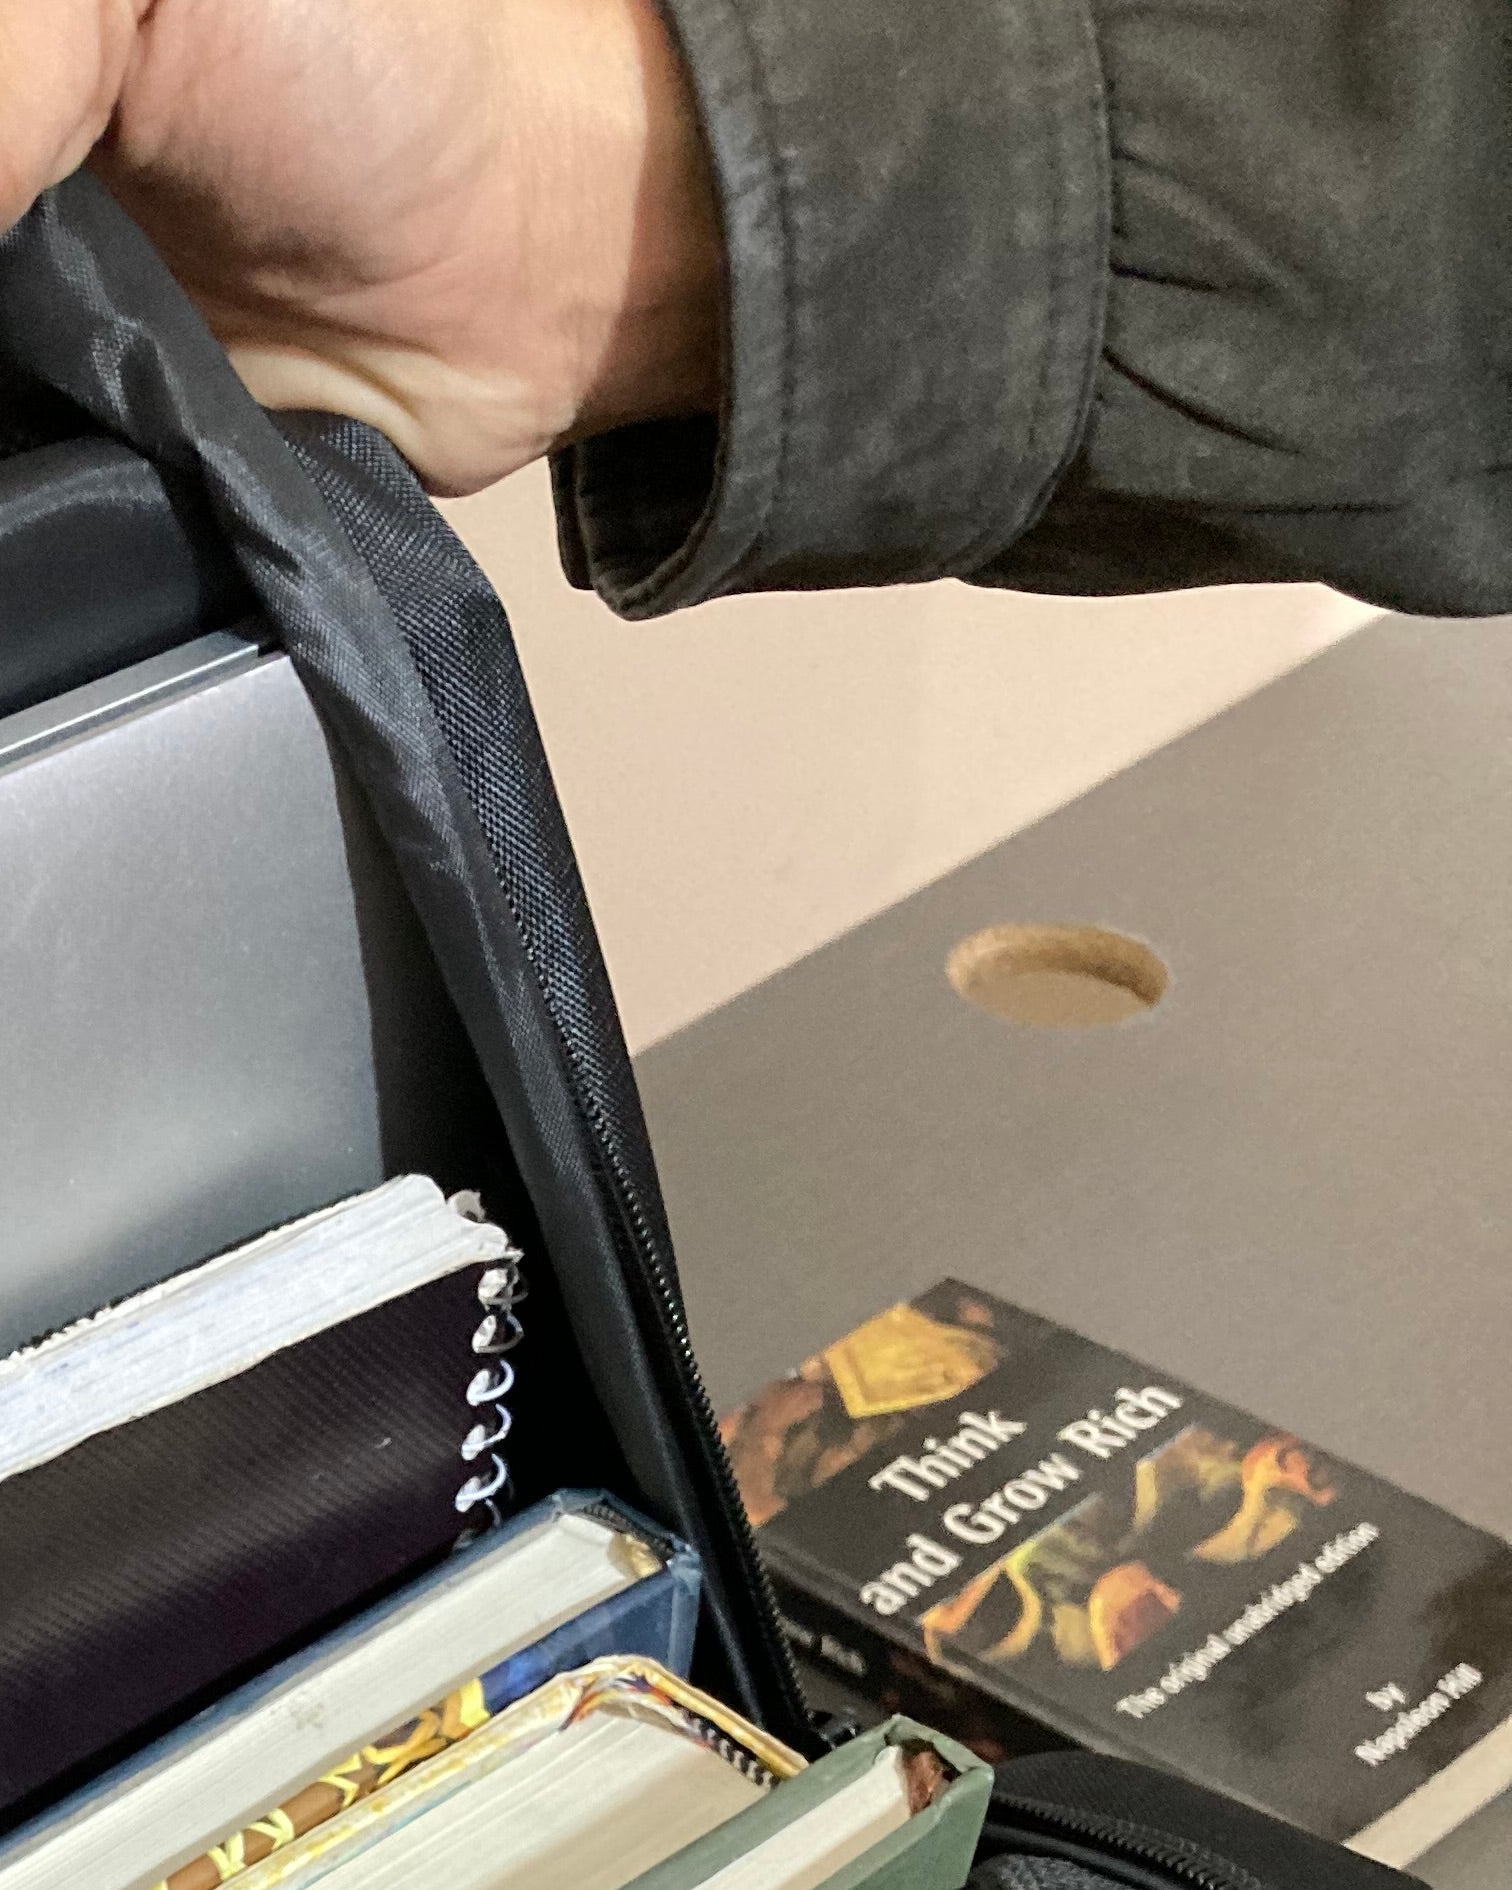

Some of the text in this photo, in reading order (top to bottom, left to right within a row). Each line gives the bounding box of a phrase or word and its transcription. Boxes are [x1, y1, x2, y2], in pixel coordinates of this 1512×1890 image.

[858, 1386, 1184, 1616] and Grow Rich
[867, 1410, 1028, 1503] Think
[1116, 1521, 1380, 1719] The original unabridged edition
[1354, 1692, 1451, 1767] Napoleon
[1365, 1681, 1406, 1711] by
